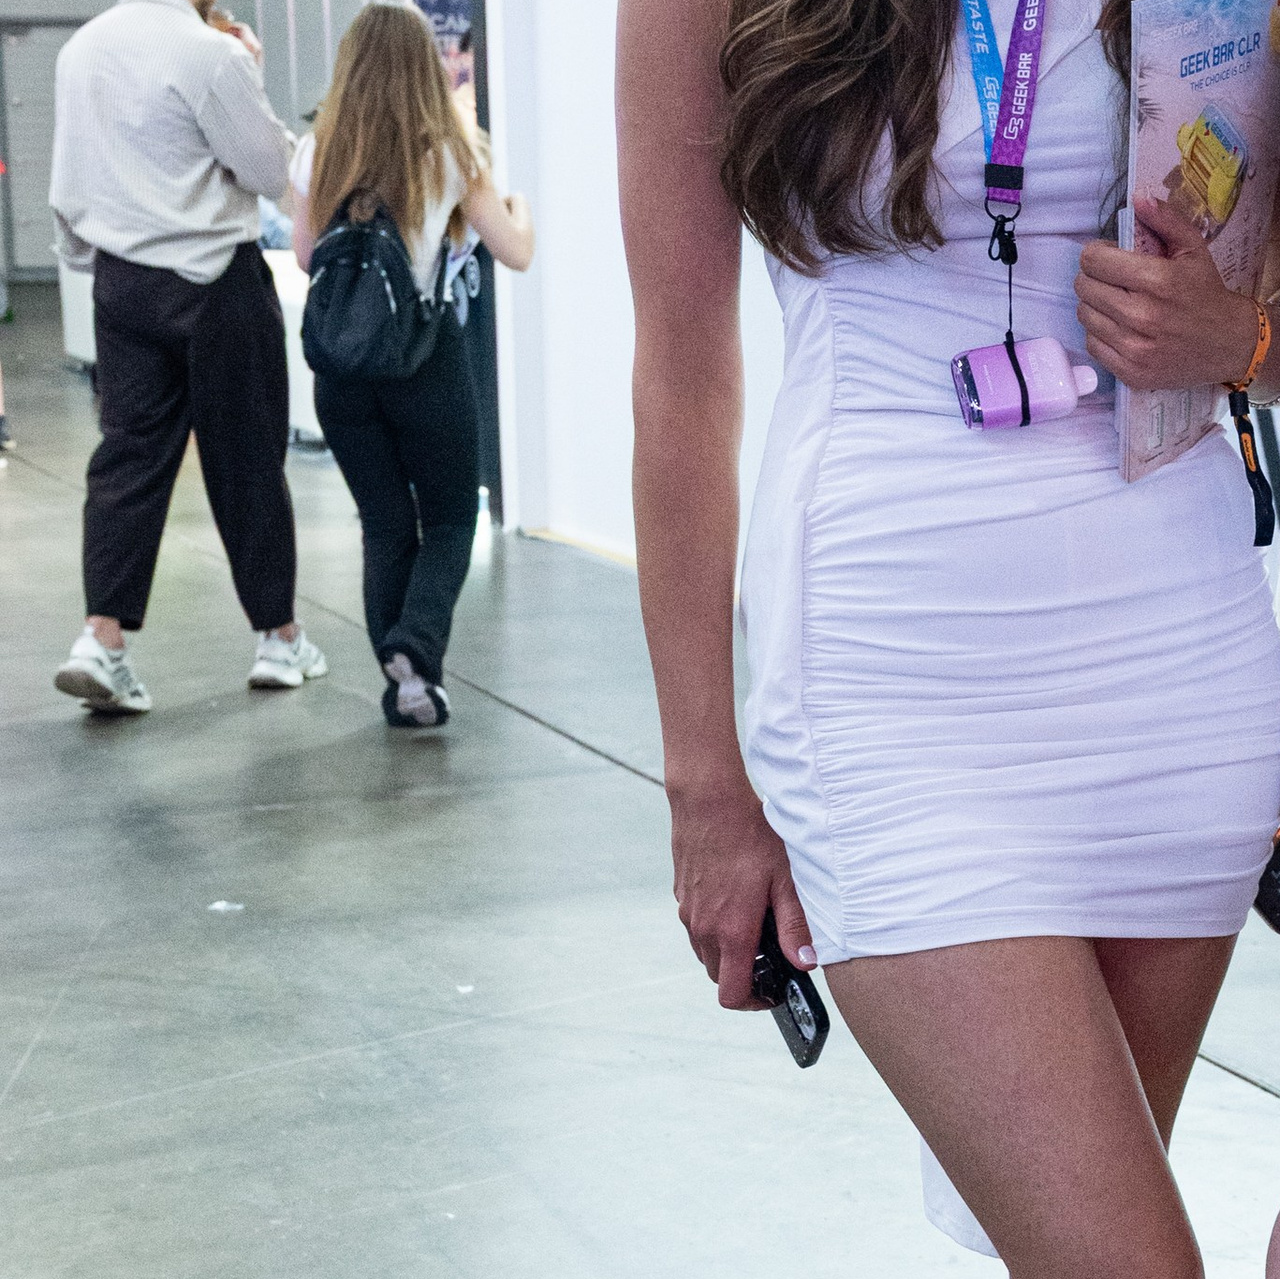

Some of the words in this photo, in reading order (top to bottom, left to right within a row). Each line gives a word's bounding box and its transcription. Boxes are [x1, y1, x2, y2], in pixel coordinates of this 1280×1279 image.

[1017, 52, 1033, 79] BAR
[1180, 48, 1211, 79] GEEK
[1212, 40, 1235, 68] BAR
[1237, 32, 1262, 57] CLR
[1189, 77, 1204, 93] THE
[1205, 69, 1231, 88] CHOICE
[1011, 80, 1029, 116] GEEK
